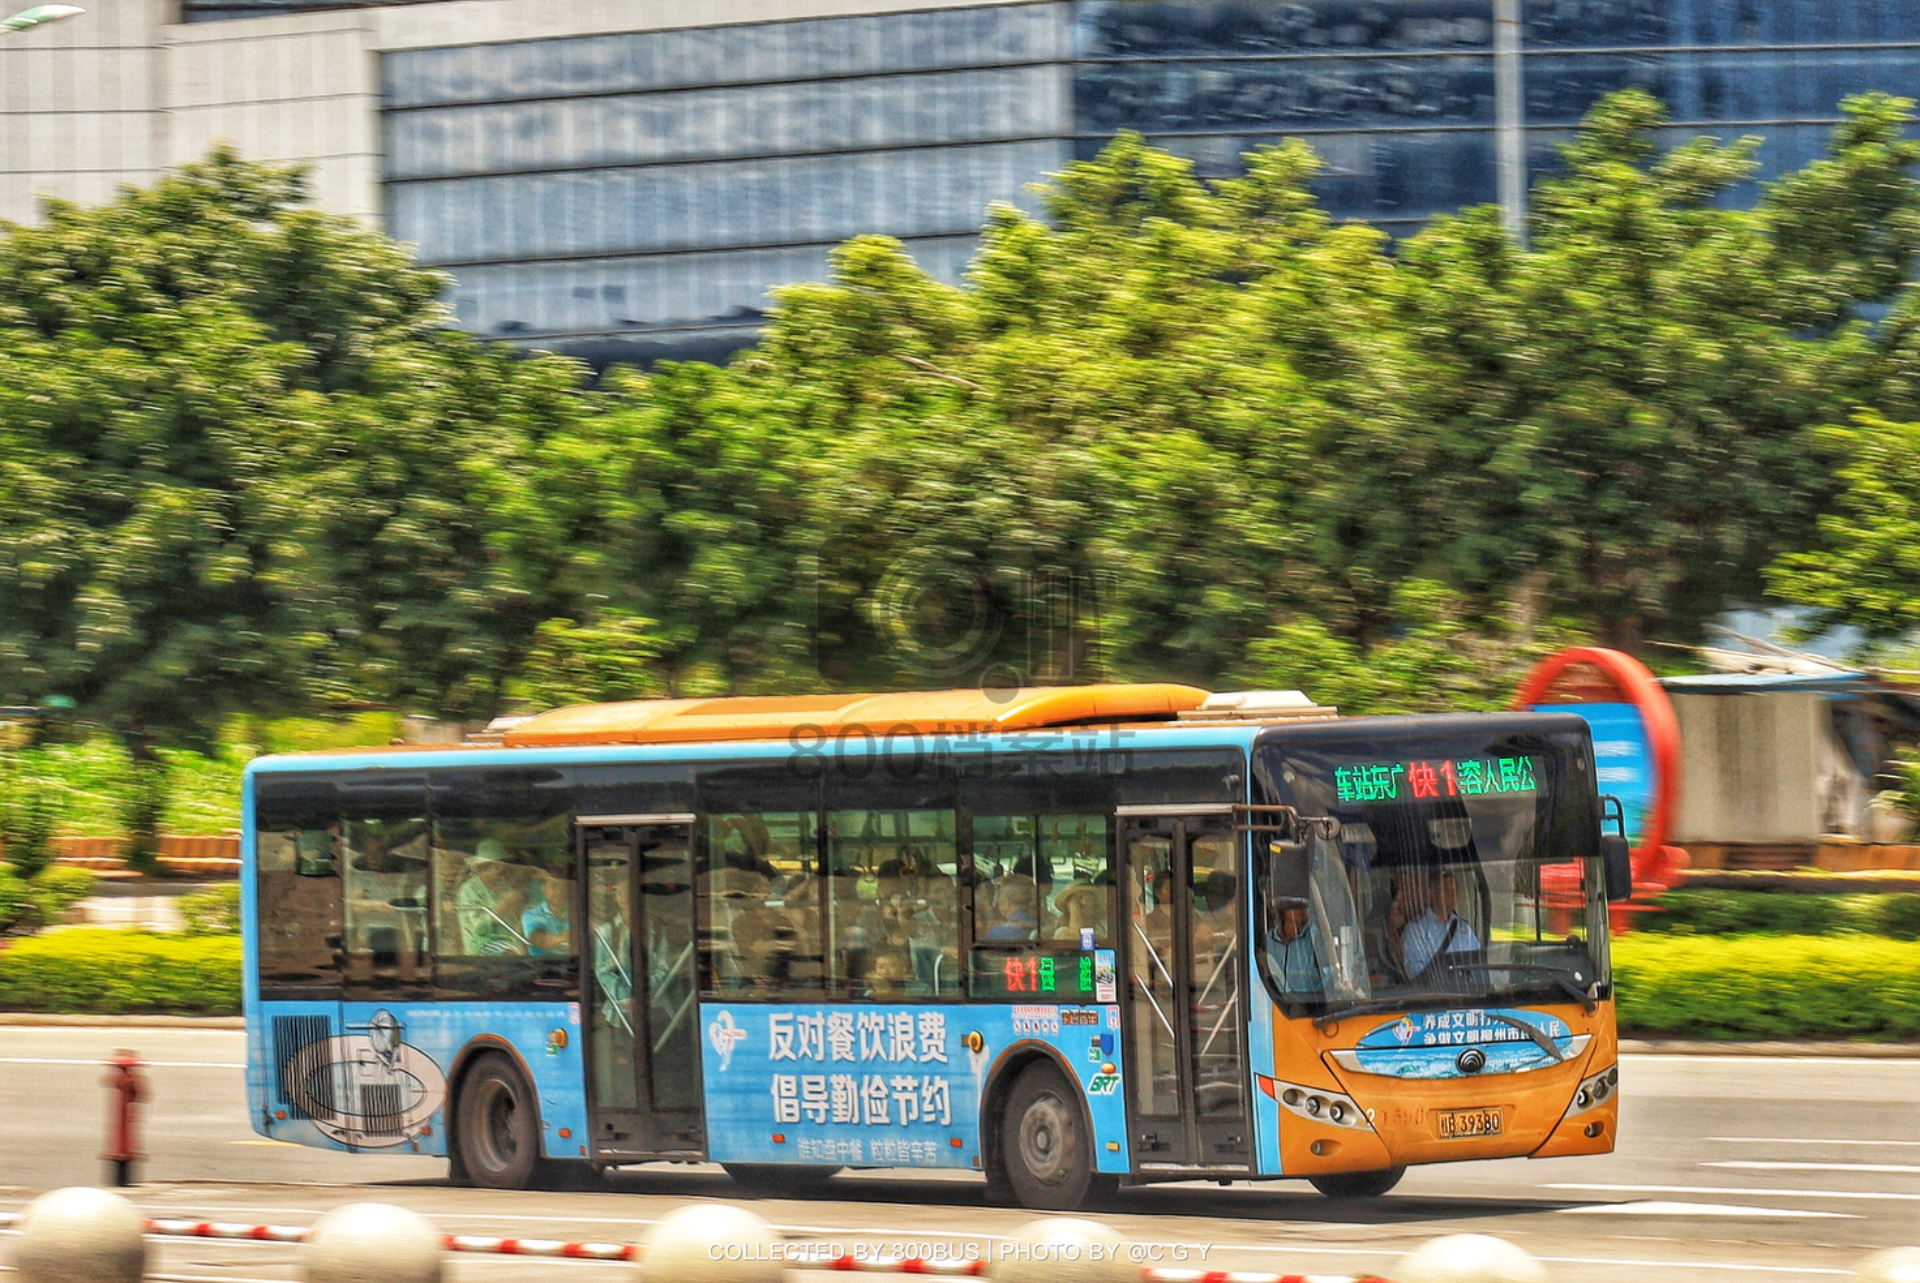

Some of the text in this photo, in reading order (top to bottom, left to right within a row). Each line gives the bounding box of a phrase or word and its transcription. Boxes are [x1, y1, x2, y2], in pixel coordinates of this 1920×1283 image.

[1335, 763, 1403, 801] 车站东广
[1408, 760, 1456, 798] 快1
[769, 1011, 948, 1063] 反对餐饮浪费
[771, 1074, 952, 1126] 倡导勤俭节约
[1090, 1075, 1119, 1092] BRT
